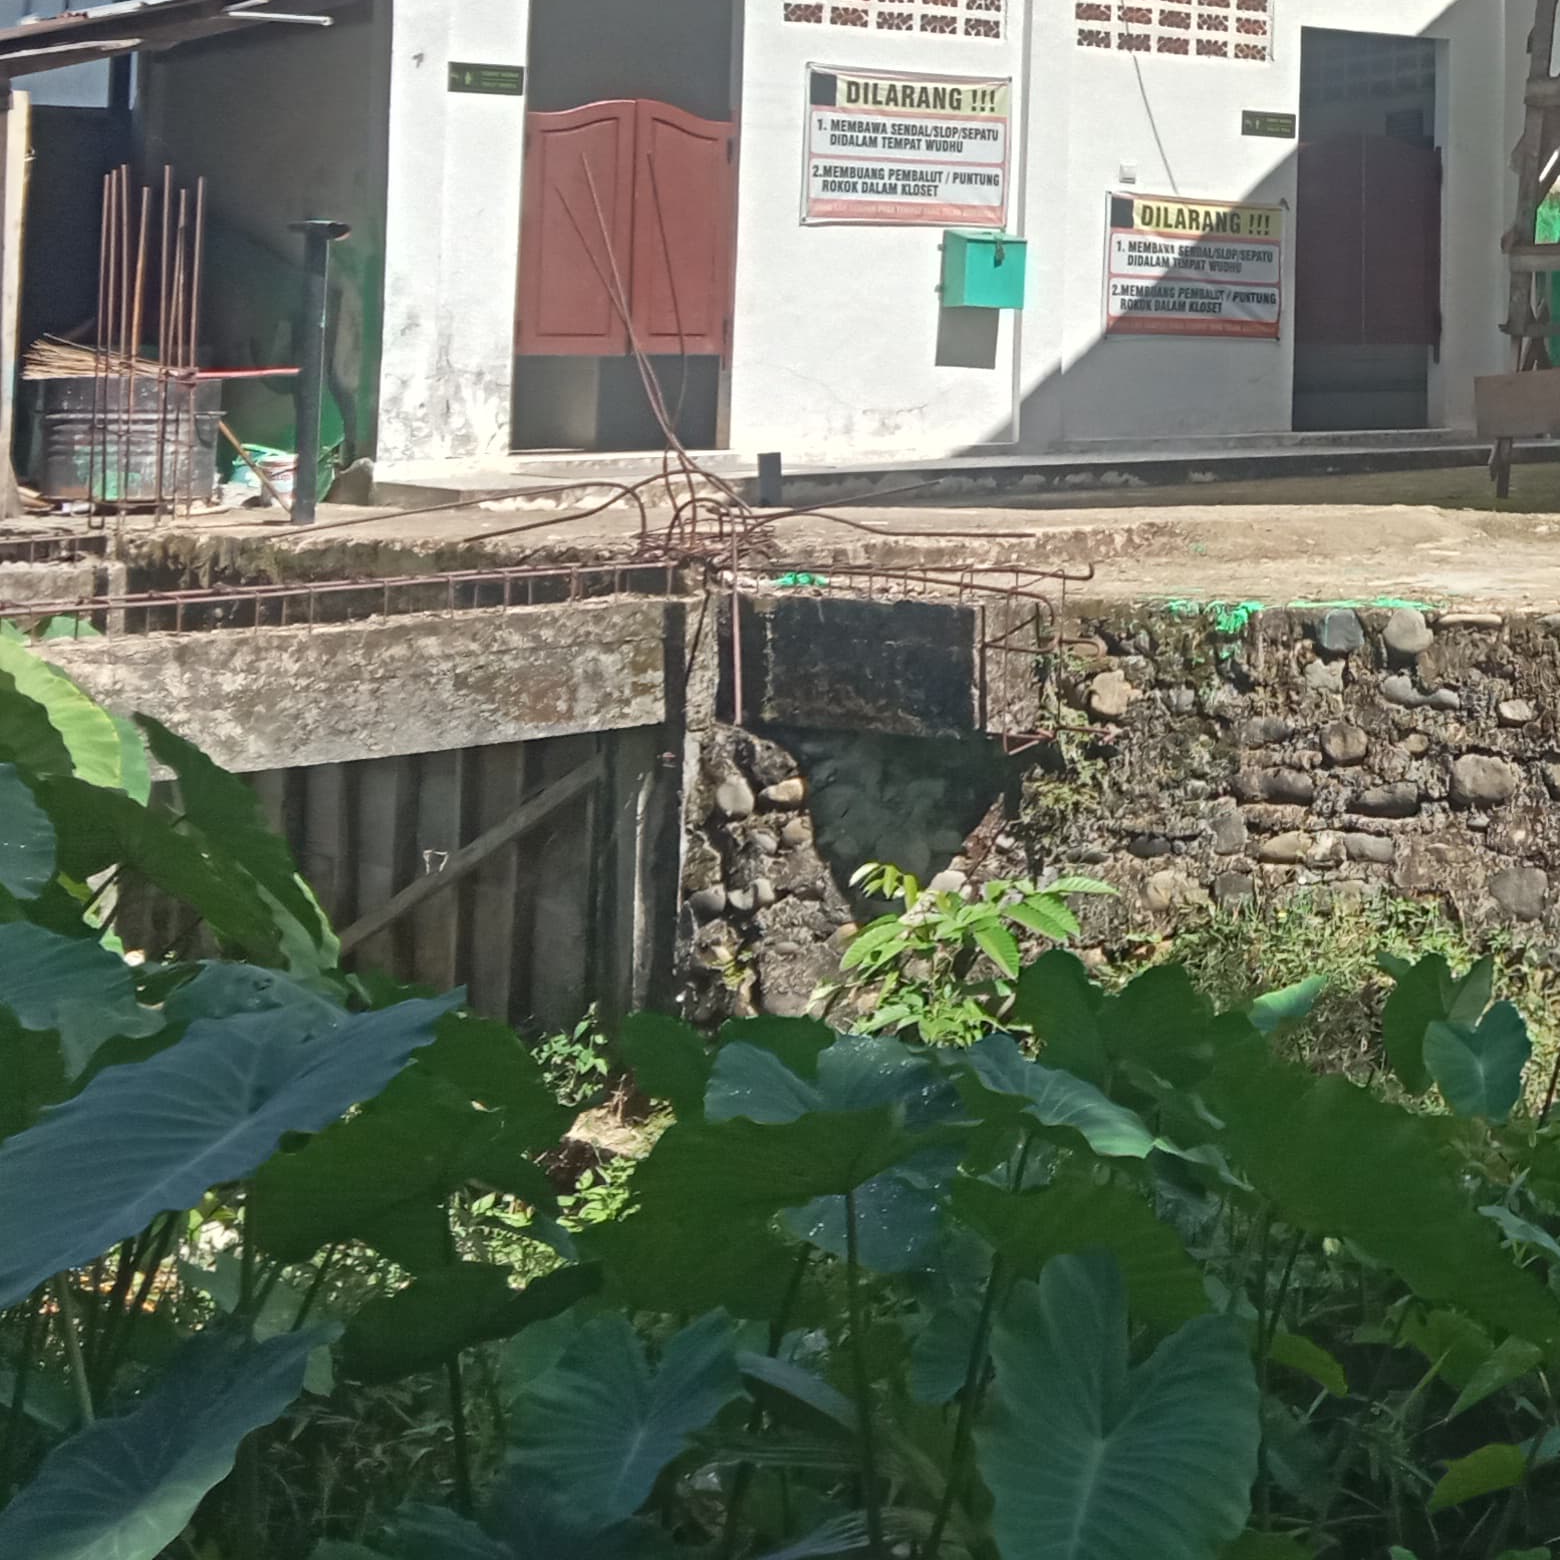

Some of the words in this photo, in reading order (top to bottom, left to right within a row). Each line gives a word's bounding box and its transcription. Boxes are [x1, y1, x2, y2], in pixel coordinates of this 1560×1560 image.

[846, 81, 962, 111] DILARANG
[971, 89, 995, 113] !!!
[817, 119, 827, 132] 1.
[830, 119, 888, 135] MEMBAWA
[890, 122, 999, 141] SENDAL/SLOP/SEPATU
[830, 133, 878, 148] DIDALAM
[881, 136, 922, 150] TEMPAT
[925, 139, 963, 153] WUDHU
[888, 168, 943, 183] PEMBALUT
[945, 171, 950, 184] /
[952, 172, 1000, 187] PUNTUNG
[822, 179, 859, 193] ROKOK
[861, 181, 898, 195] DALAM
[901, 183, 938, 197] KLOSET
[1141, 204, 1241, 235] DILARANG
[1249, 214, 1270, 236] !!!
[1117, 240, 1125, 253] 1.
[1127, 254, 1170, 268] DIDALAM
[1188, 301, 1222, 313] KLOSET
